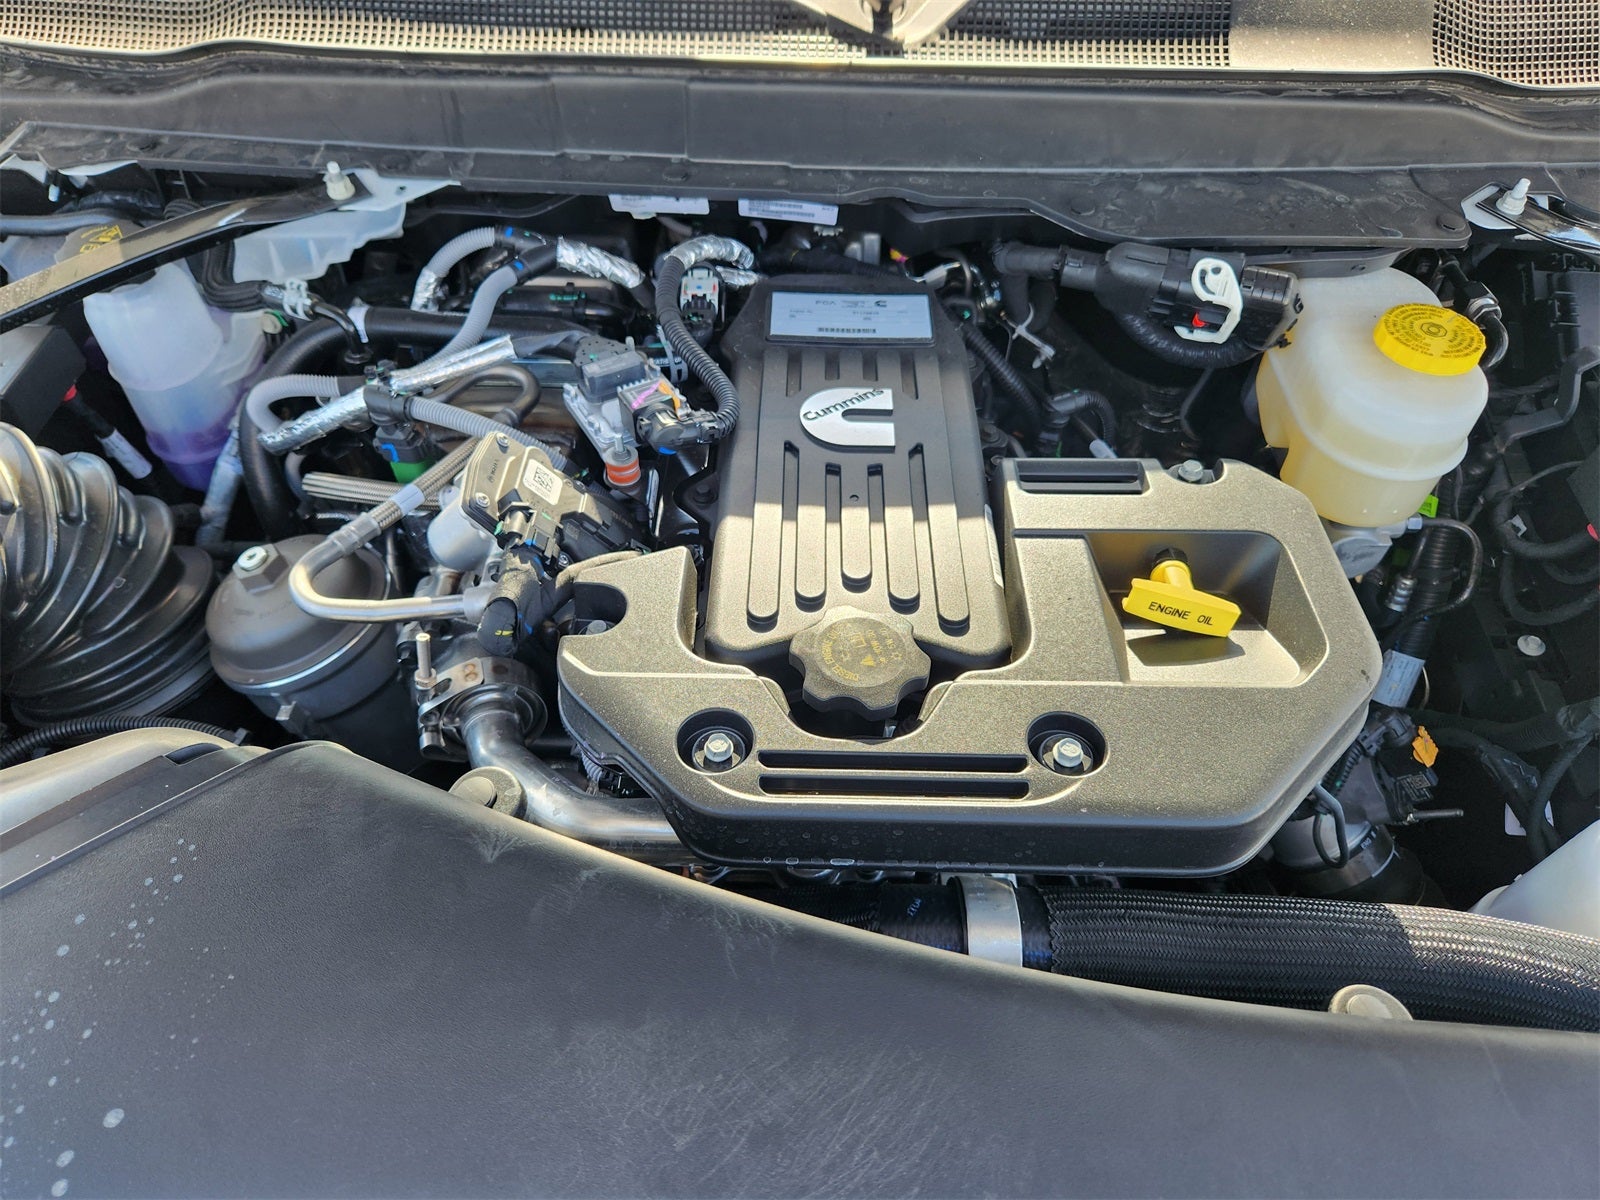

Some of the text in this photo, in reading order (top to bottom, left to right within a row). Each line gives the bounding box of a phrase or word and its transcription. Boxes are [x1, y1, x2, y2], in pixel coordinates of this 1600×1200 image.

[803, 389, 885, 421] Cummins
[1148, 601, 1214, 626] ENGINE OIL
